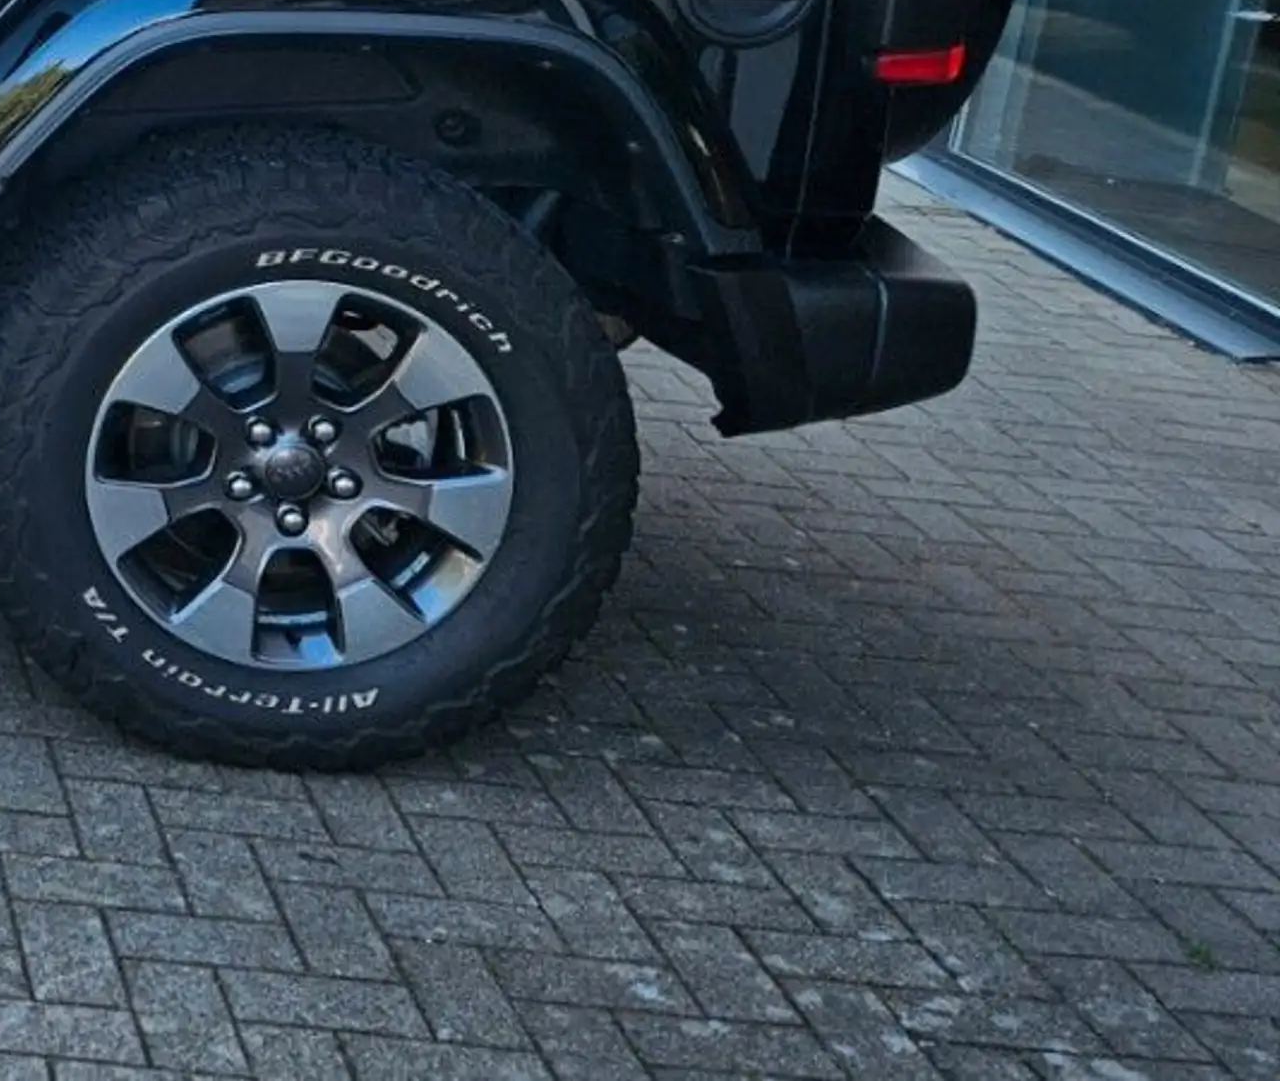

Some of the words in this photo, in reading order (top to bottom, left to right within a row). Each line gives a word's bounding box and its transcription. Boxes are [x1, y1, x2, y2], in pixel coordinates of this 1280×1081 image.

[255, 247, 514, 353] BFGoodrich
[83, 586, 130, 643] T/A
[141, 648, 379, 714] All-Terrain
